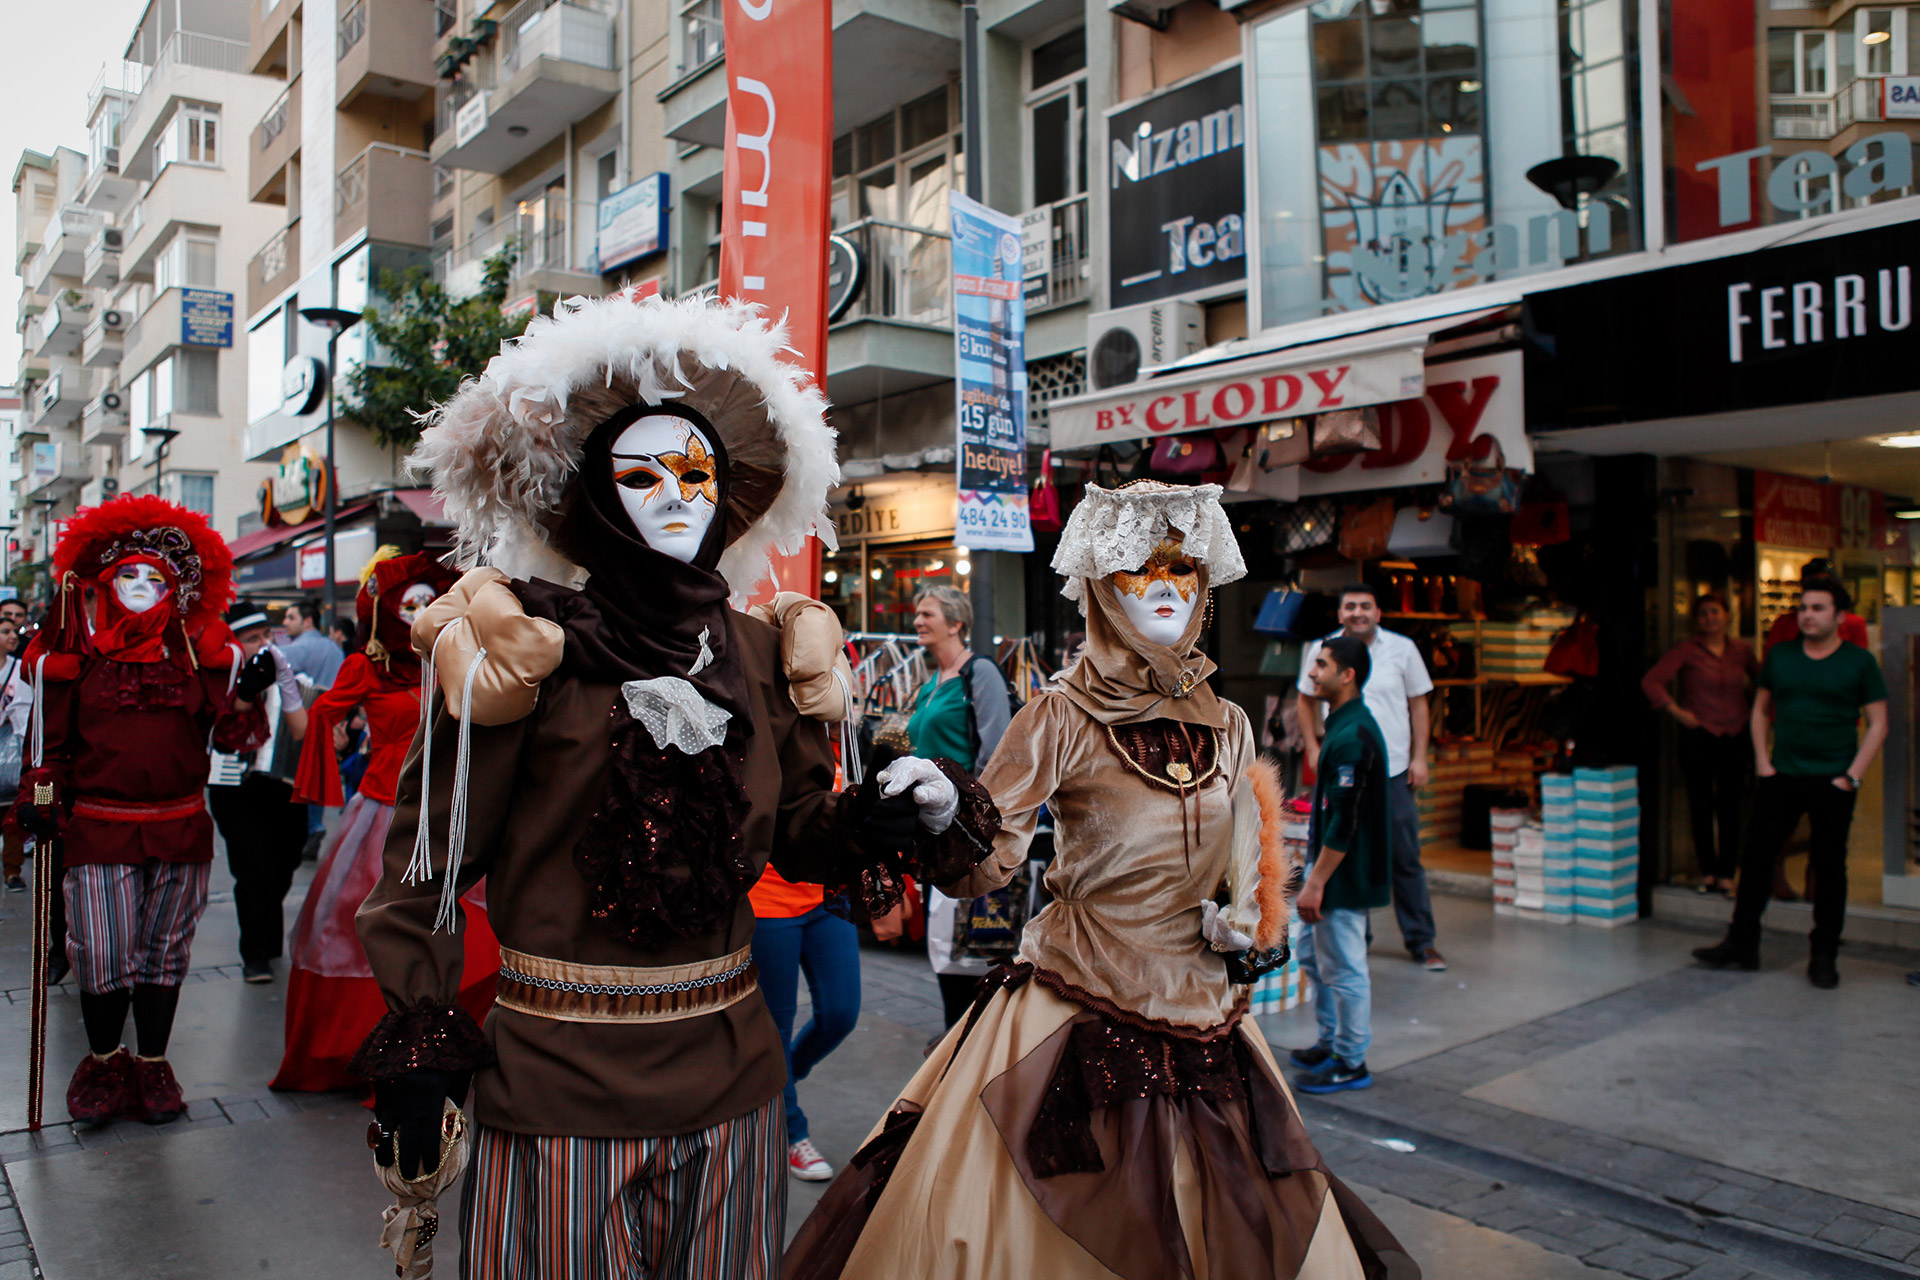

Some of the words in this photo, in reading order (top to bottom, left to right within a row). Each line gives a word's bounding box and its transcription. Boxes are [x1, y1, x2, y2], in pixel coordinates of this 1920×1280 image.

[1112, 103, 1244, 189] Nizam
[1695, 131, 1913, 228] Tea
[1161, 213, 1244, 275] Tea
[960, 333, 969, 353] 3
[1149, 306, 1163, 362] arçelik
[1727, 265, 1912, 363] FERRU
[961, 404, 985, 430] 15
[988, 411, 1014, 437] gün
[1095, 402, 1136, 431] BY
[1144, 365, 1353, 432] CLODY
[964, 444, 1023, 479] hediye!
[960, 507, 987, 527] 484
[991, 510, 1008, 528] 24
[1011, 511, 1027, 529] 90
